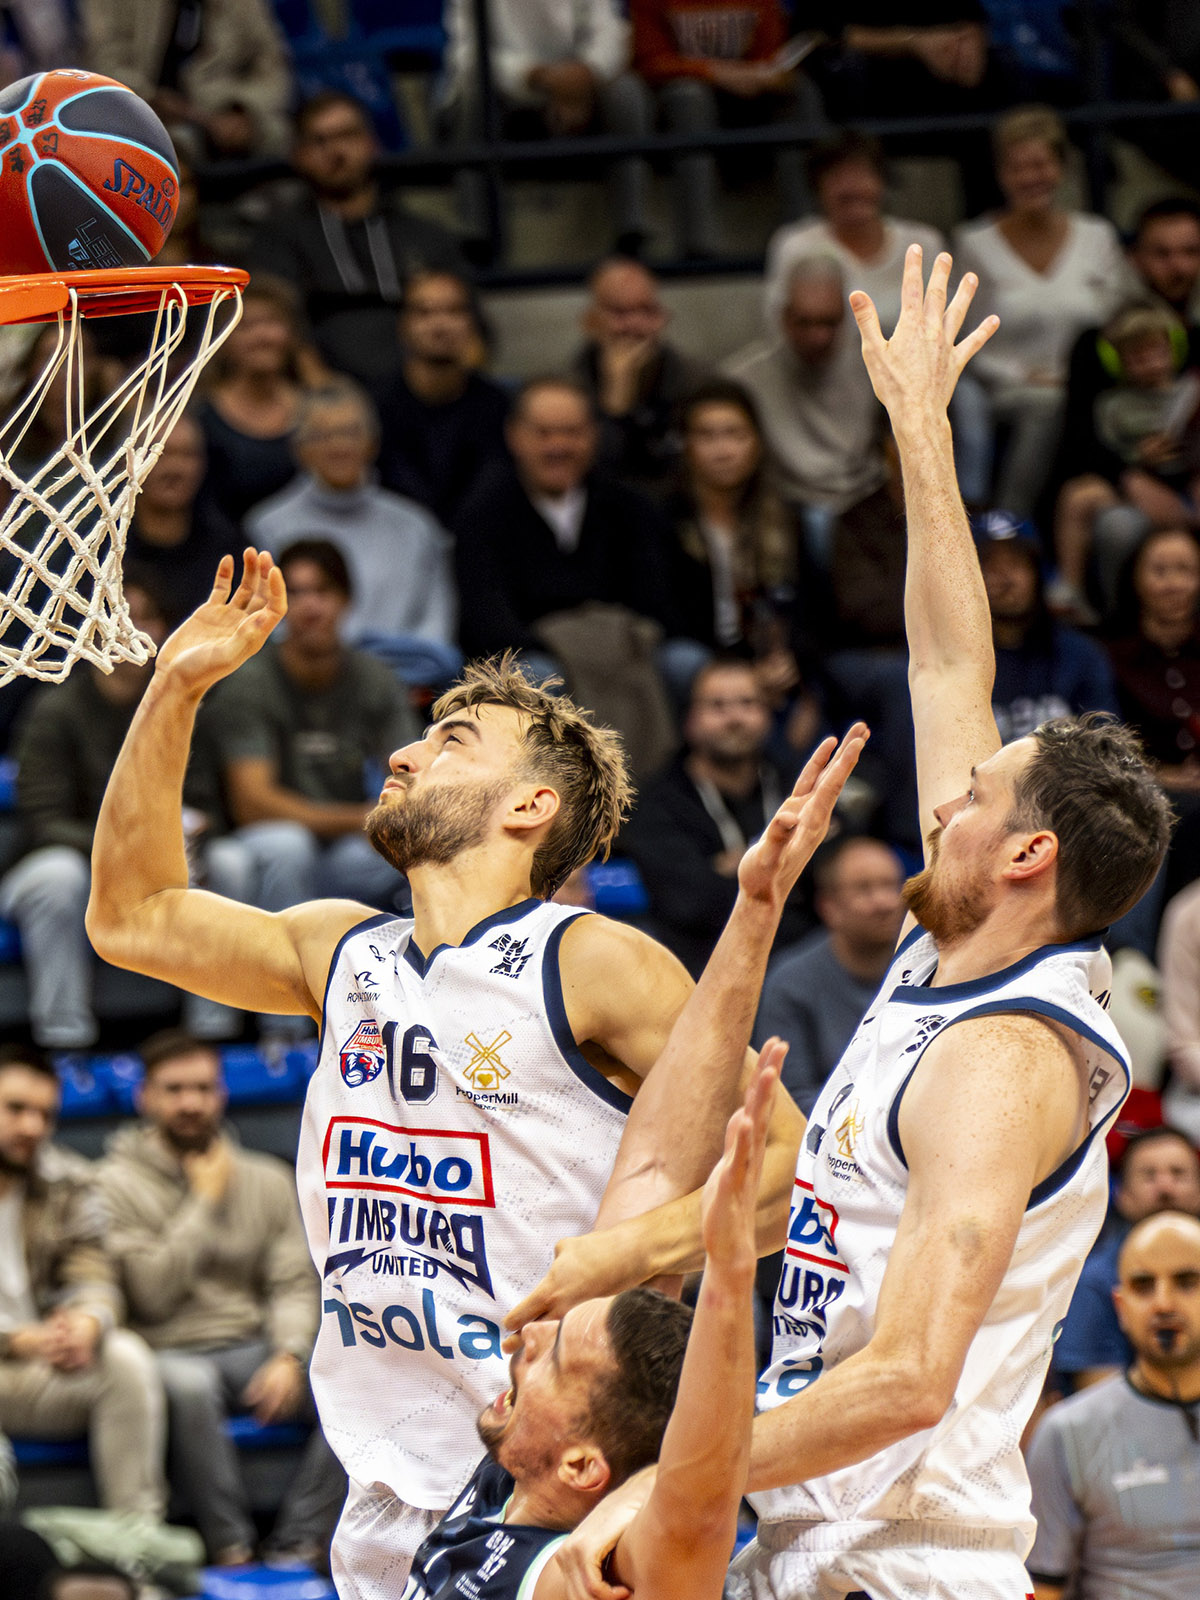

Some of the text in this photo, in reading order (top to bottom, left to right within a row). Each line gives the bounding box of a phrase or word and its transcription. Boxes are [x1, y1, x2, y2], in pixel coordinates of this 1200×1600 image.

[360, 1026, 380, 1036] Hub
[382, 1021, 440, 1106] 16
[337, 1129, 473, 1192] Hubo
[371, 1251, 439, 1280] UNITED
